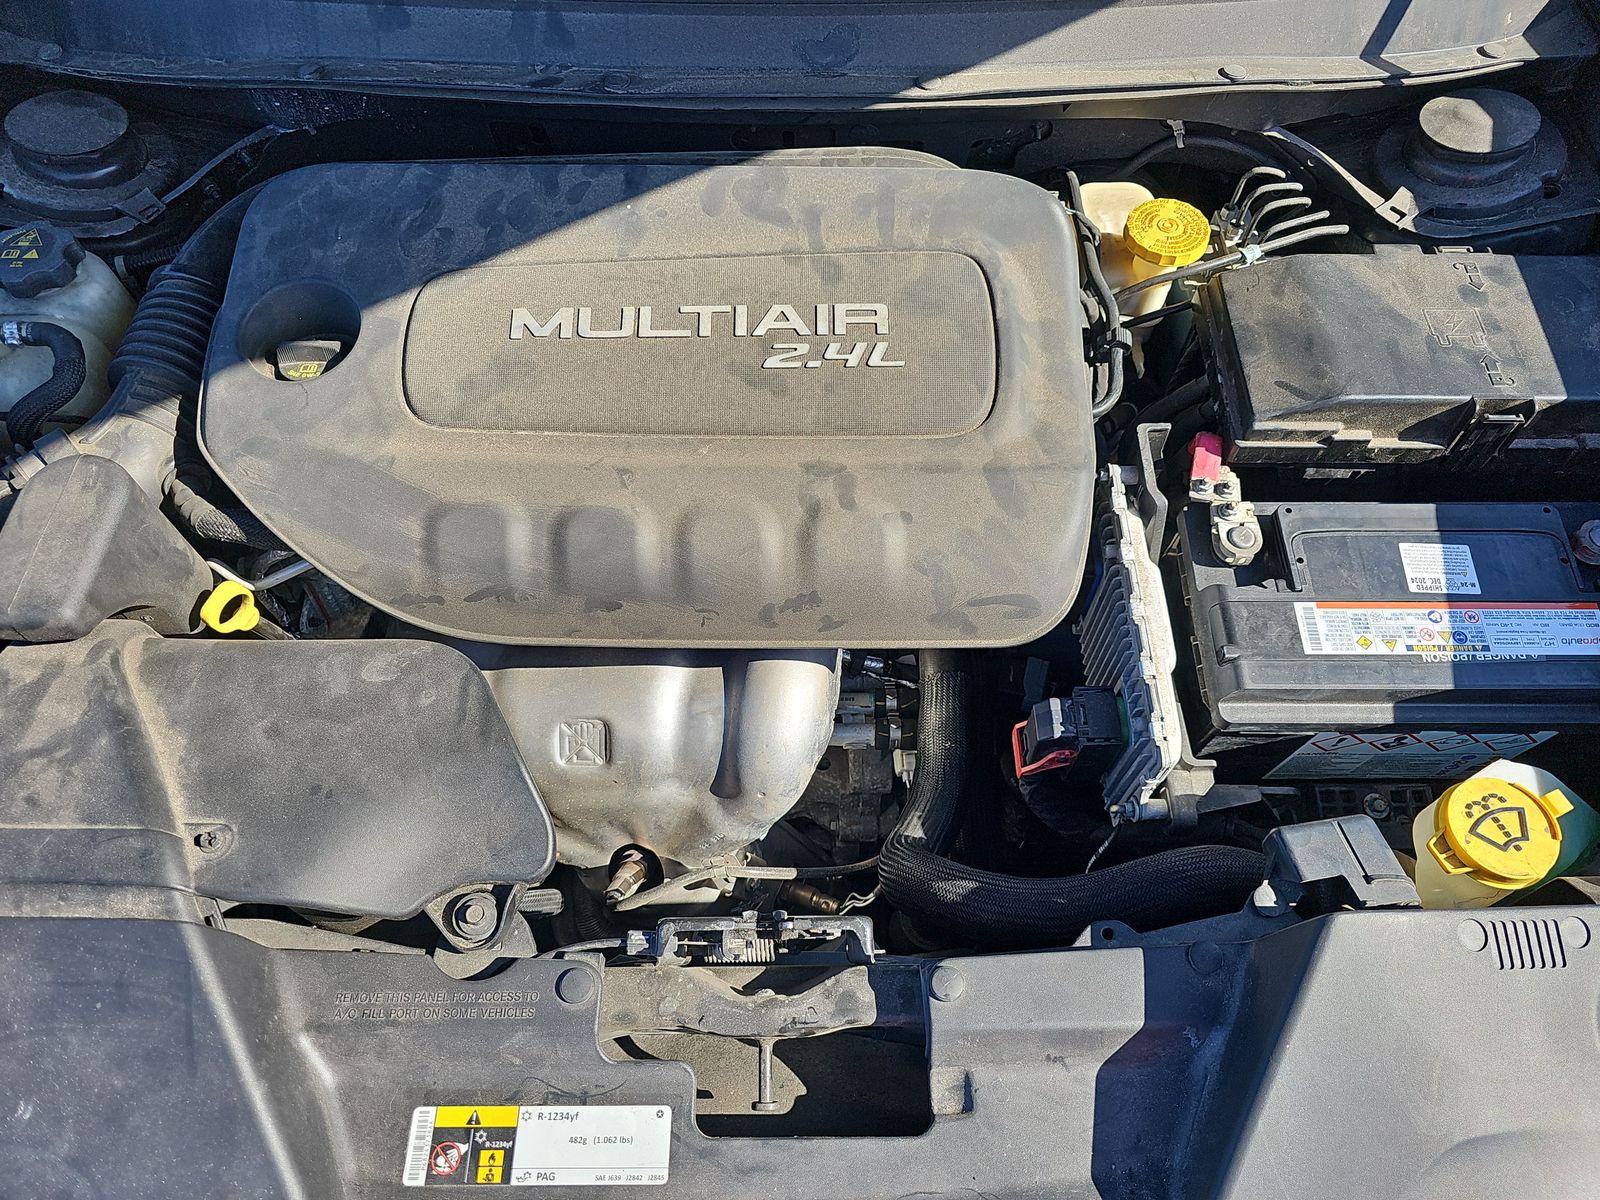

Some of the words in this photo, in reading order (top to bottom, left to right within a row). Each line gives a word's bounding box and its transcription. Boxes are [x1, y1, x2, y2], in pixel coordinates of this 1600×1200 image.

[509, 304, 889, 339] MULTIAIR
[762, 341, 905, 369] 2.4L
[1427, 577, 1442, 585] DEC.
[1415, 584, 1443, 592] SHIPPED
[1421, 654, 1467, 662] POISON
[335, 992, 382, 1003] REMOVE
[385, 992, 410, 1003] THIS
[414, 992, 449, 1003] PANEL
[452, 991, 475, 1002] FOR
[478, 991, 522, 1002] ACCESS
[524, 991, 540, 1001] TO
[334, 1008, 357, 1019] A/C
[362, 1008, 385, 1018] FILL
[389, 1008, 419, 1019] PORT
[423, 1008, 440, 1018] ON
[443, 1008, 476, 1018] SOME
[480, 1007, 535, 1018] VEHICLES
[537, 1112, 580, 1122] R-1234yf
[485, 1140, 513, 1149] R-1234yf
[568, 1136, 588, 1145] 482g
[593, 1136, 618, 1145] (1.062
[619, 1136, 634, 1145] lbs)
[536, 1172, 556, 1182] PAG
[594, 1174, 606, 1182] SAE
[607, 1174, 622, 1182] J639
[625, 1174, 643, 1182] J2842
[647, 1174, 665, 1182] J2845
